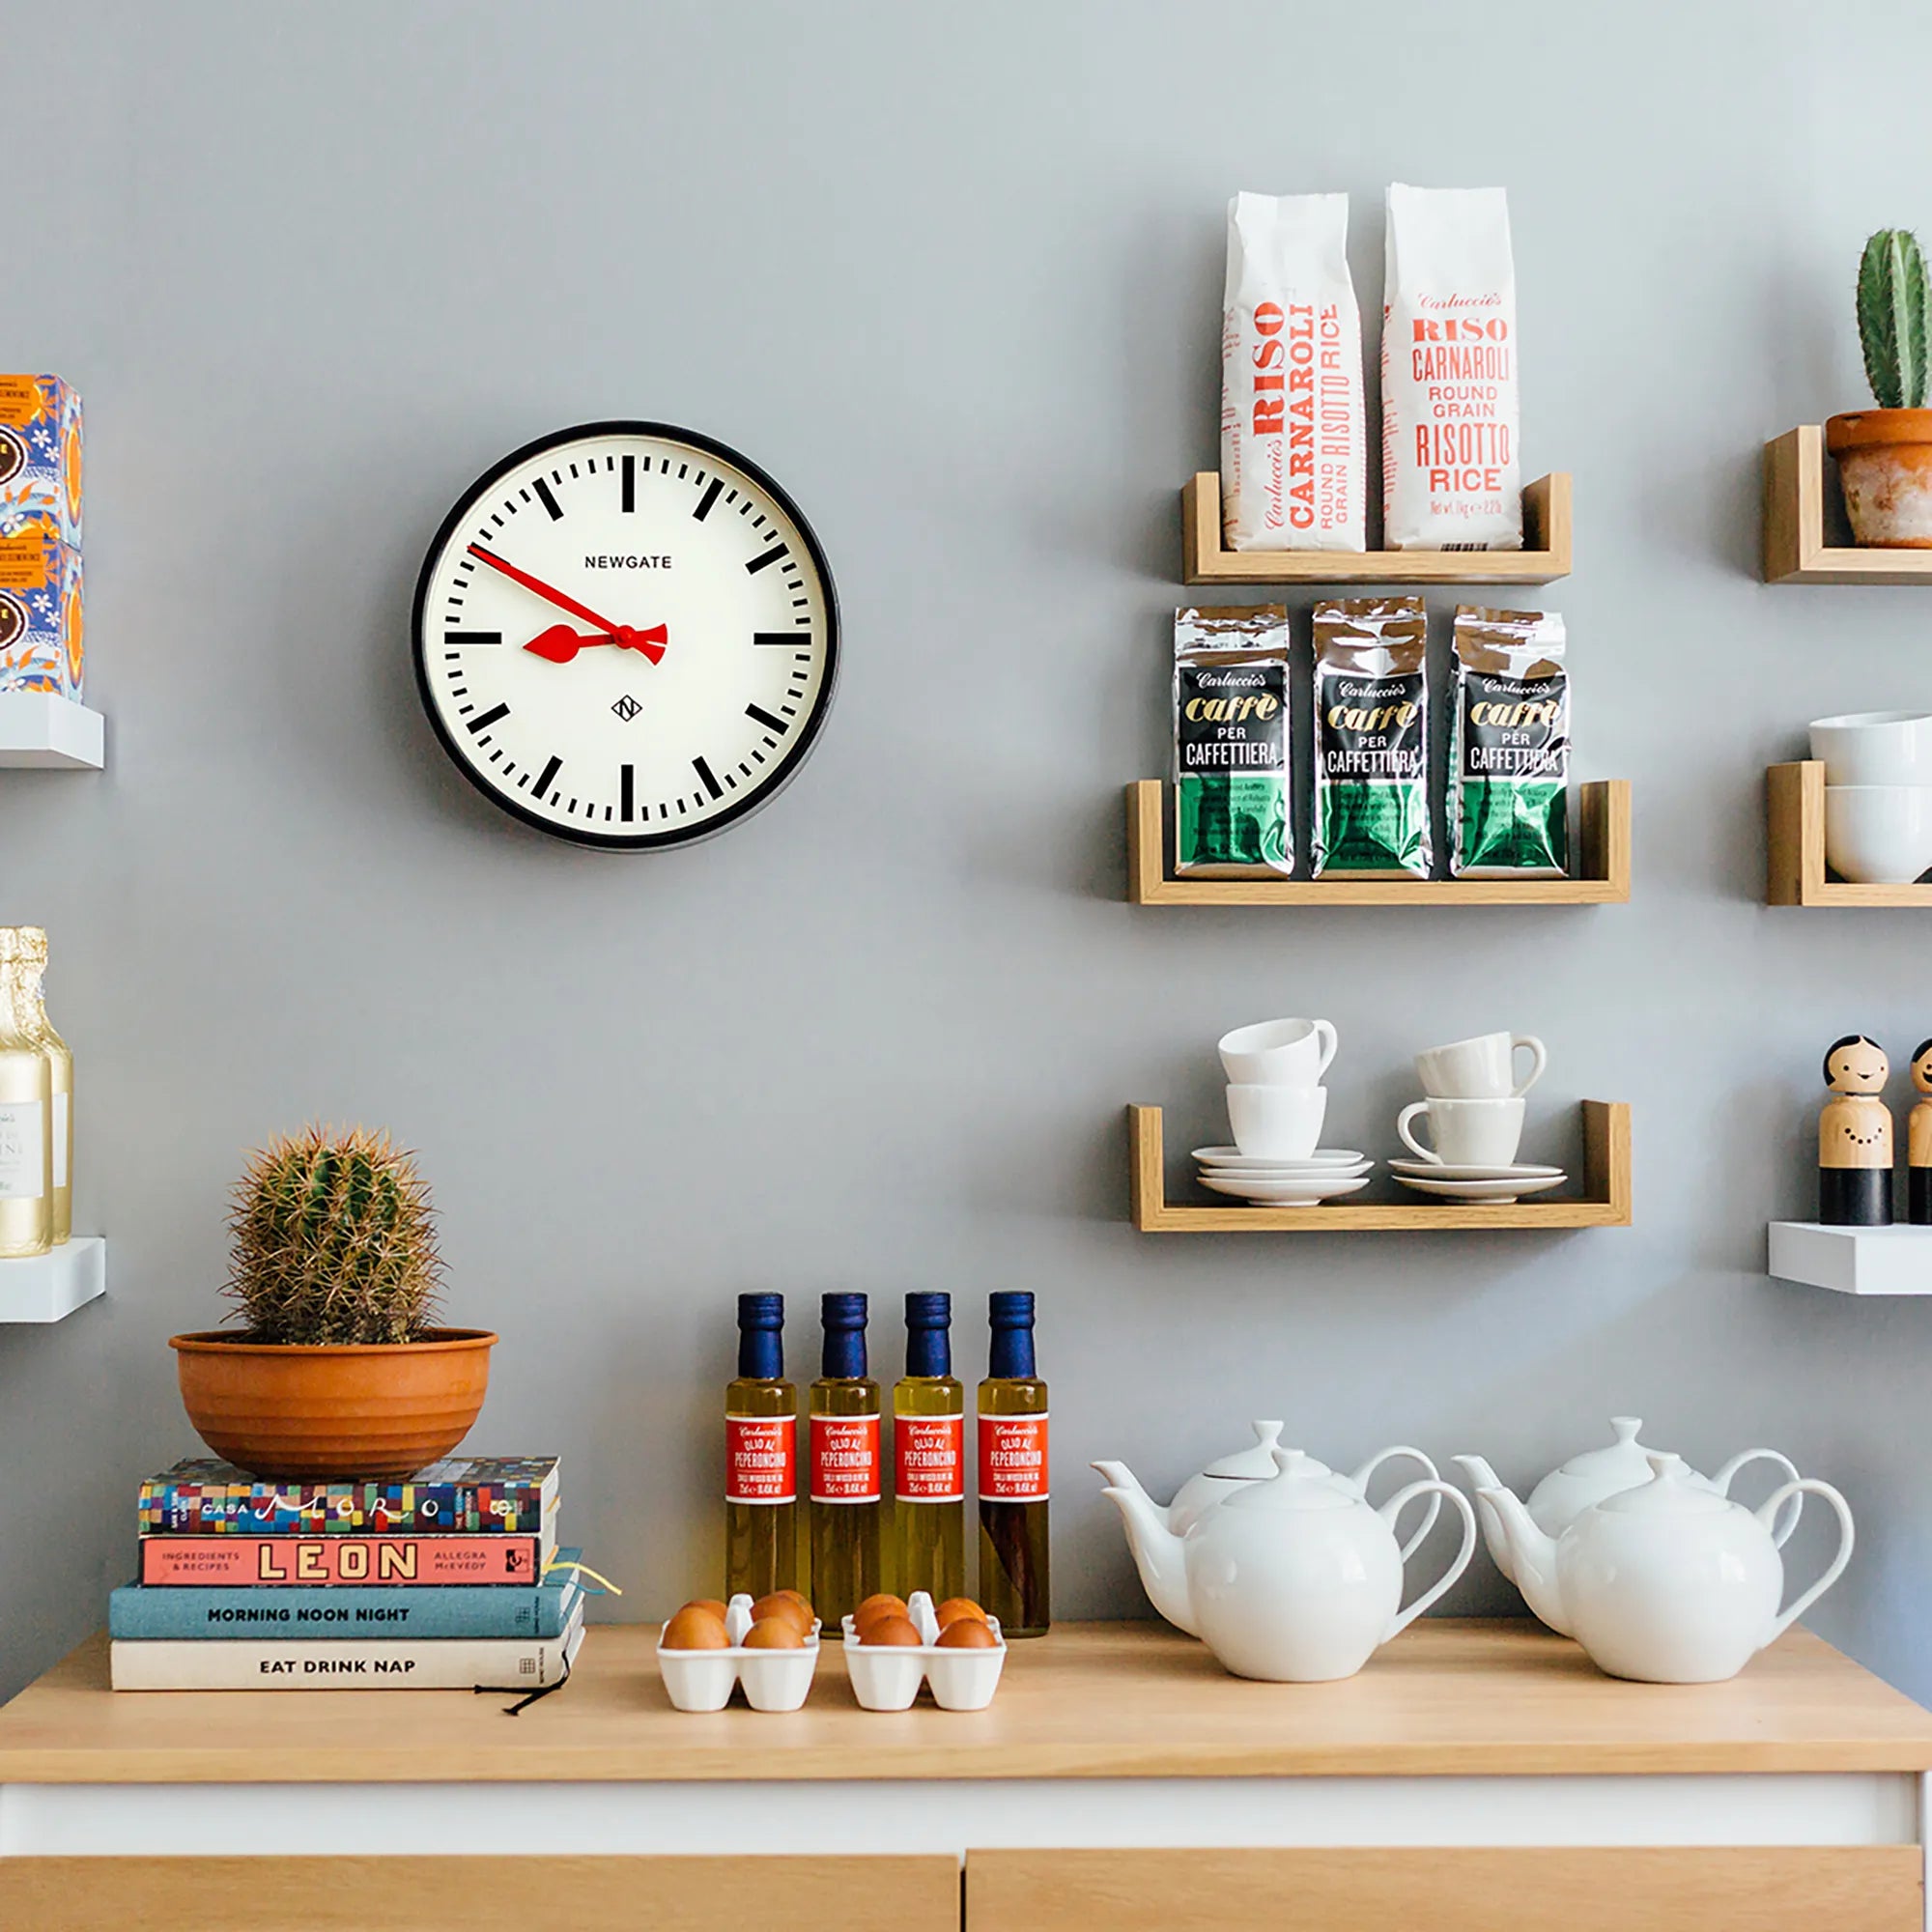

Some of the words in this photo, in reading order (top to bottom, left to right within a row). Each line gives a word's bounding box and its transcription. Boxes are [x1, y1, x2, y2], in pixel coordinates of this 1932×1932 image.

[1418, 293, 1502, 309] Carluccio's
[1321, 303, 1341, 370] RICE
[1412, 318, 1508, 342] RISO
[1252, 301, 1285, 437] RISO
[1412, 346, 1509, 382] CARNAROLI
[1429, 385, 1497, 401] ROUND
[1290, 303, 1314, 529] CARNAROLI
[1321, 375, 1350, 457] RISOTTO
[1433, 402, 1495, 418] GRAIN
[1415, 423, 1510, 467] RISOTTO
[1264, 439, 1285, 530] Carluccio's
[1430, 468, 1502, 493] RICE
[1321, 463, 1333, 530] ROUND
[1335, 464, 1349, 524] GRAIN
[584, 555, 672, 569] NEWGATE
[1196, 671, 1266, 689] Carluccio's
[1339, 681, 1406, 698] Carluccio's
[1482, 677, 1550, 695] Carluccio's
[1185, 693, 1278, 723] caffè
[1328, 700, 1418, 732] caffè
[1217, 727, 1247, 740] PER
[1358, 736, 1387, 749] PER
[1501, 733, 1530, 746] PER
[1186, 742, 1278, 765] CAFFETTIERA
[1327, 751, 1417, 773] CAFFETTIERA
[202, 1503, 248, 1515] CASA
[254, 1493, 439, 1519] MORO
[258, 1544, 417, 1579] LEON
[434, 1551, 487, 1560] ALLEGRA
[208, 1608, 290, 1622] MORNING
[297, 1608, 349, 1622] NOON
[355, 1608, 410, 1622] NIGHT
[260, 1661, 296, 1673] EAT
[304, 1661, 366, 1673] DRINK
[374, 1661, 415, 1673] NAP
